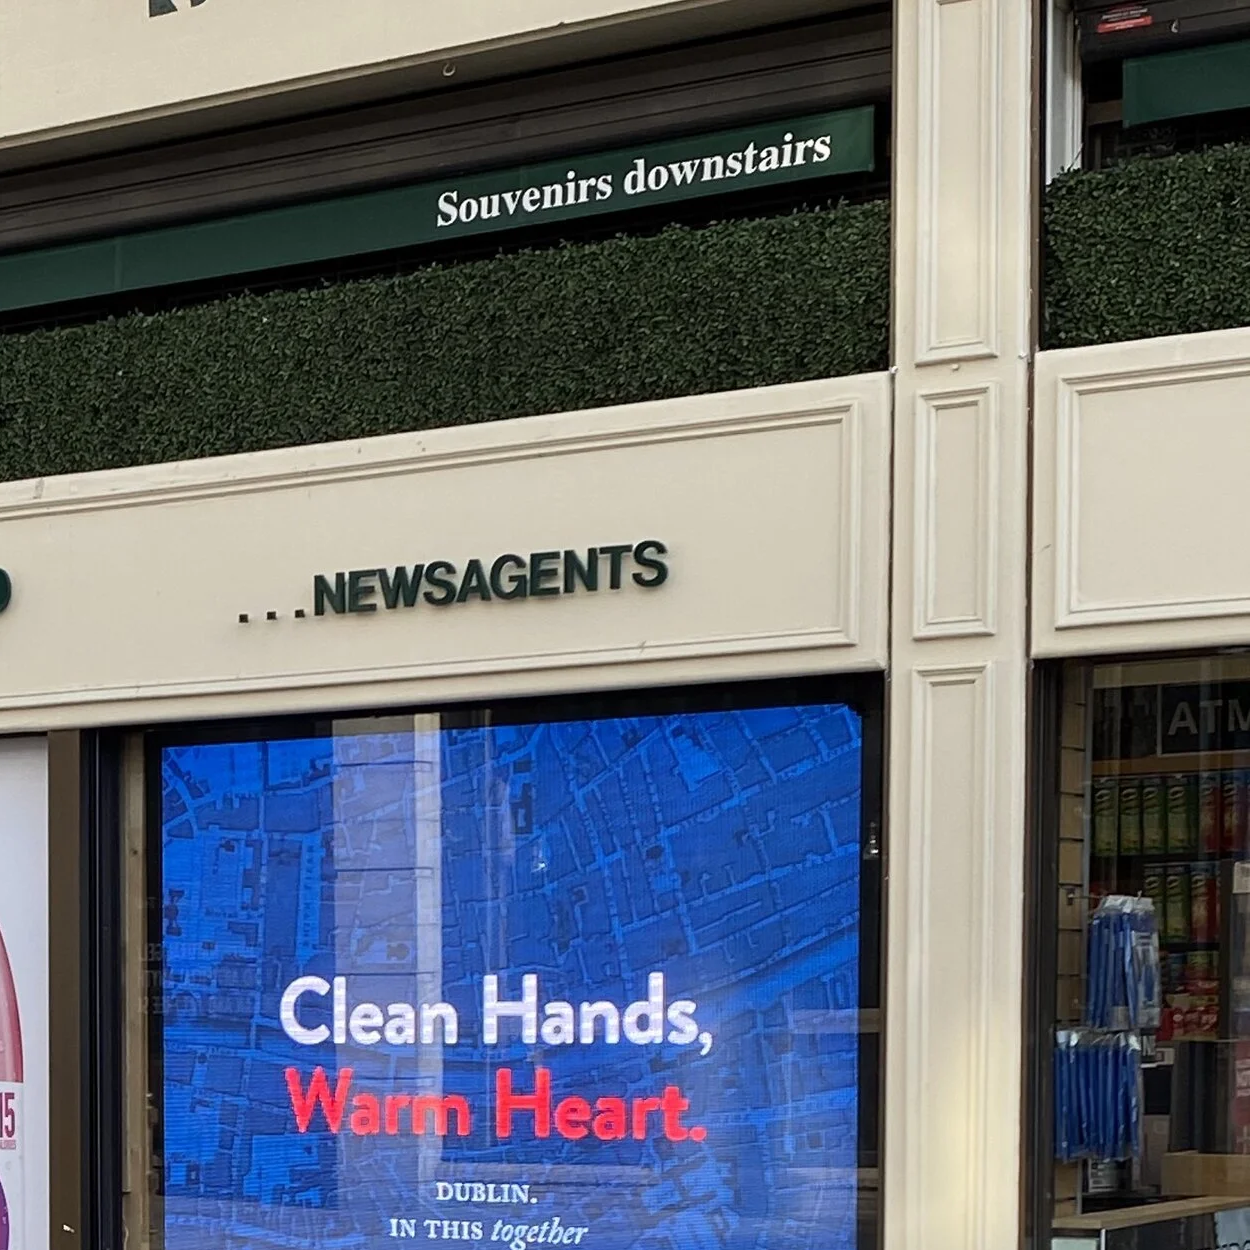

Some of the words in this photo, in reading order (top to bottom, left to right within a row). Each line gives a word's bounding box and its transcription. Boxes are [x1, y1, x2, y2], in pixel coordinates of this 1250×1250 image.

[436, 170, 613, 228] Souvenirs
[623, 131, 833, 195] downstairs
[1167, 698, 1250, 736] ATM
[279, 975, 459, 1045] Clean
[482, 972, 713, 1056] Hands,
[284, 1067, 472, 1136] Warm
[495, 1067, 708, 1142] Heart.
[436, 1182, 539, 1205] DUBLIN.
[389, 1218, 416, 1238] IN
[423, 1219, 484, 1242] THIS
[490, 1217, 589, 1250] together
